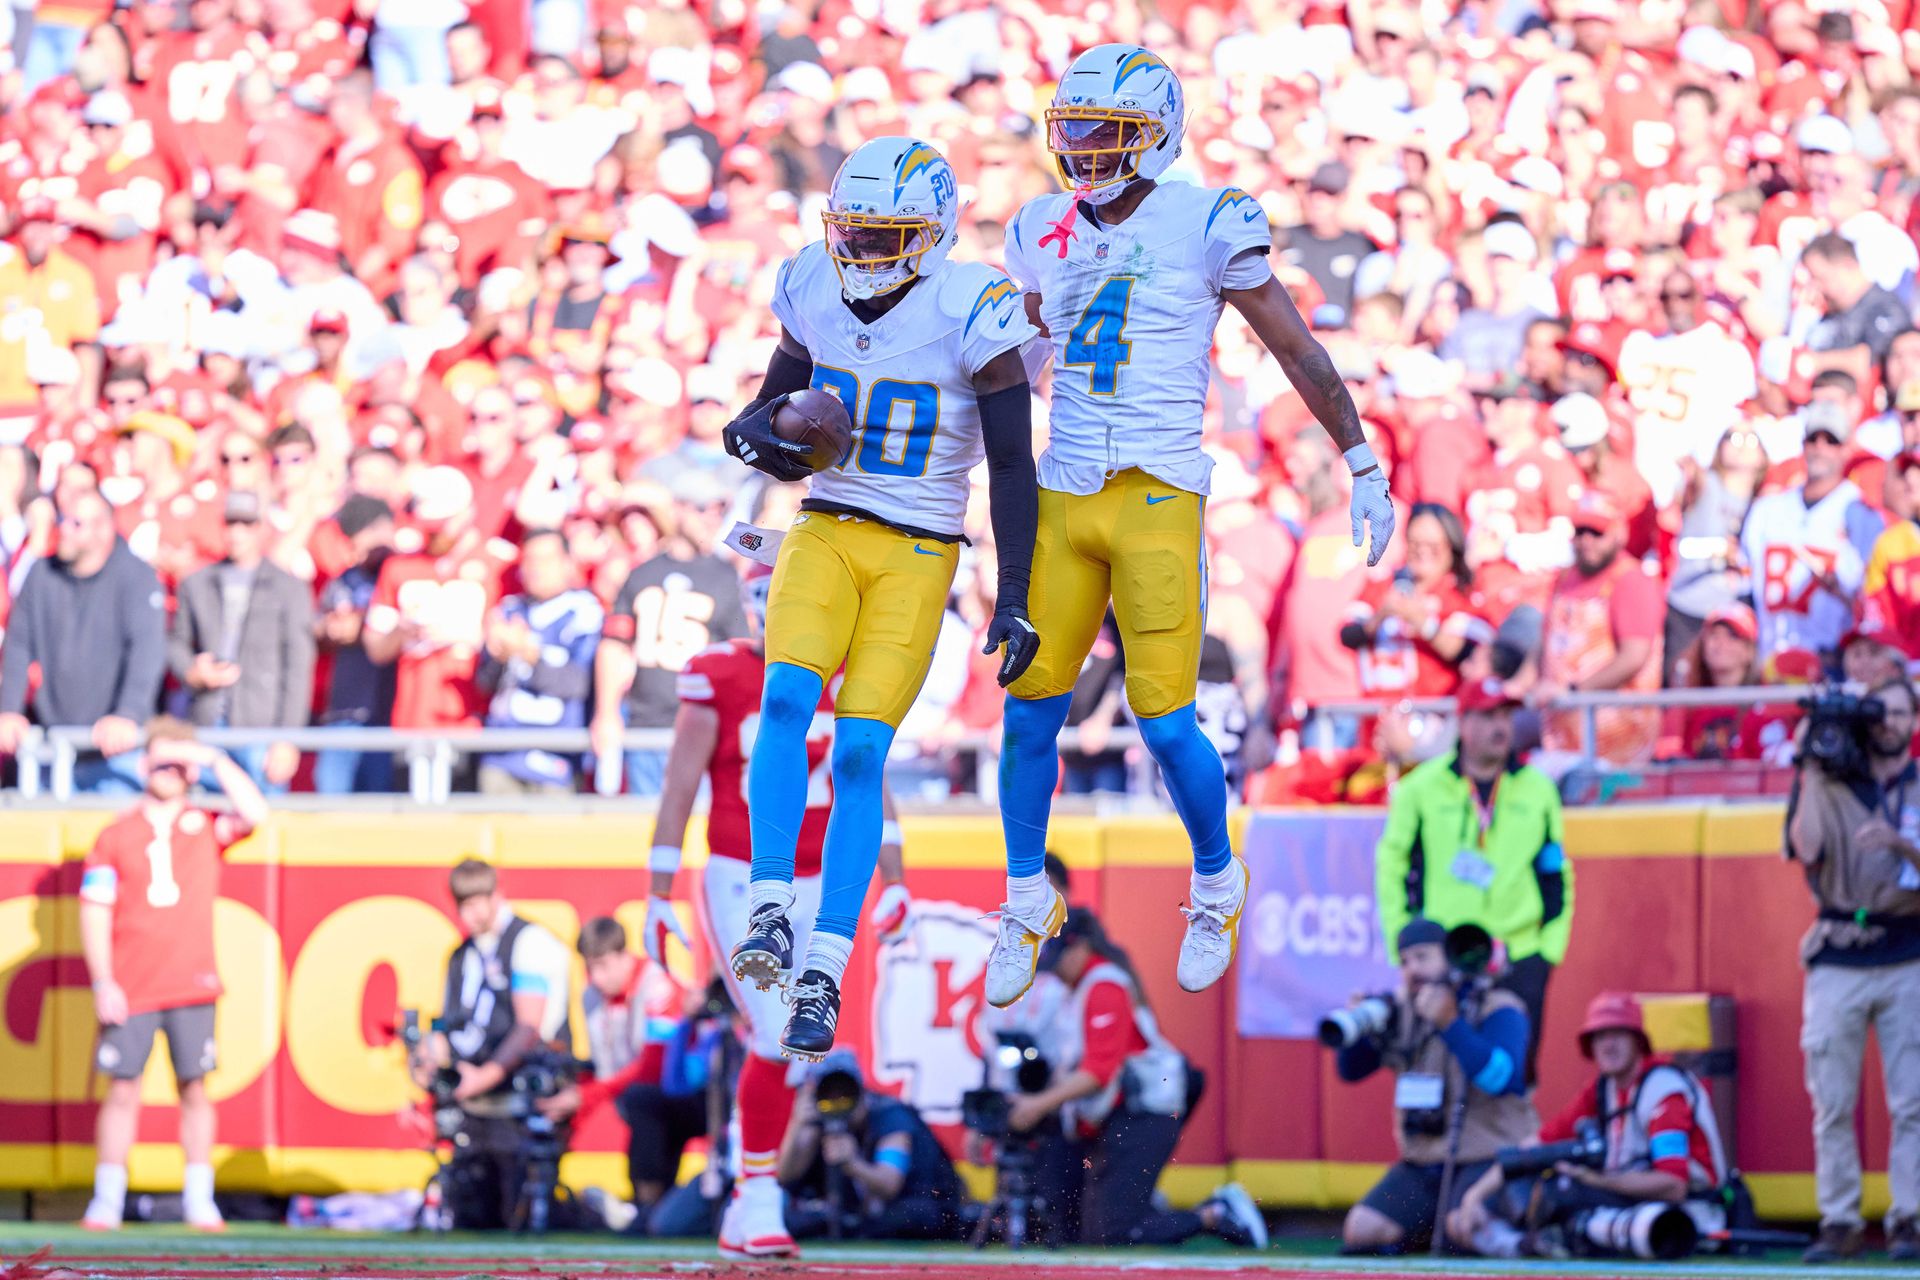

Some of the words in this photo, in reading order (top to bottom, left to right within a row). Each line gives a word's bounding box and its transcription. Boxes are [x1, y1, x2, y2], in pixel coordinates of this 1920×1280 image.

[1166, 82, 1176, 113] 4
[930, 167, 954, 206] 20
[1064, 277, 1136, 396] 4
[779, 442, 801, 452] ADIZERO
[1765, 544, 1839, 616] 87
[633, 585, 716, 672] 15
[145, 838, 181, 908] 1
[1289, 894, 1372, 956] CBS
